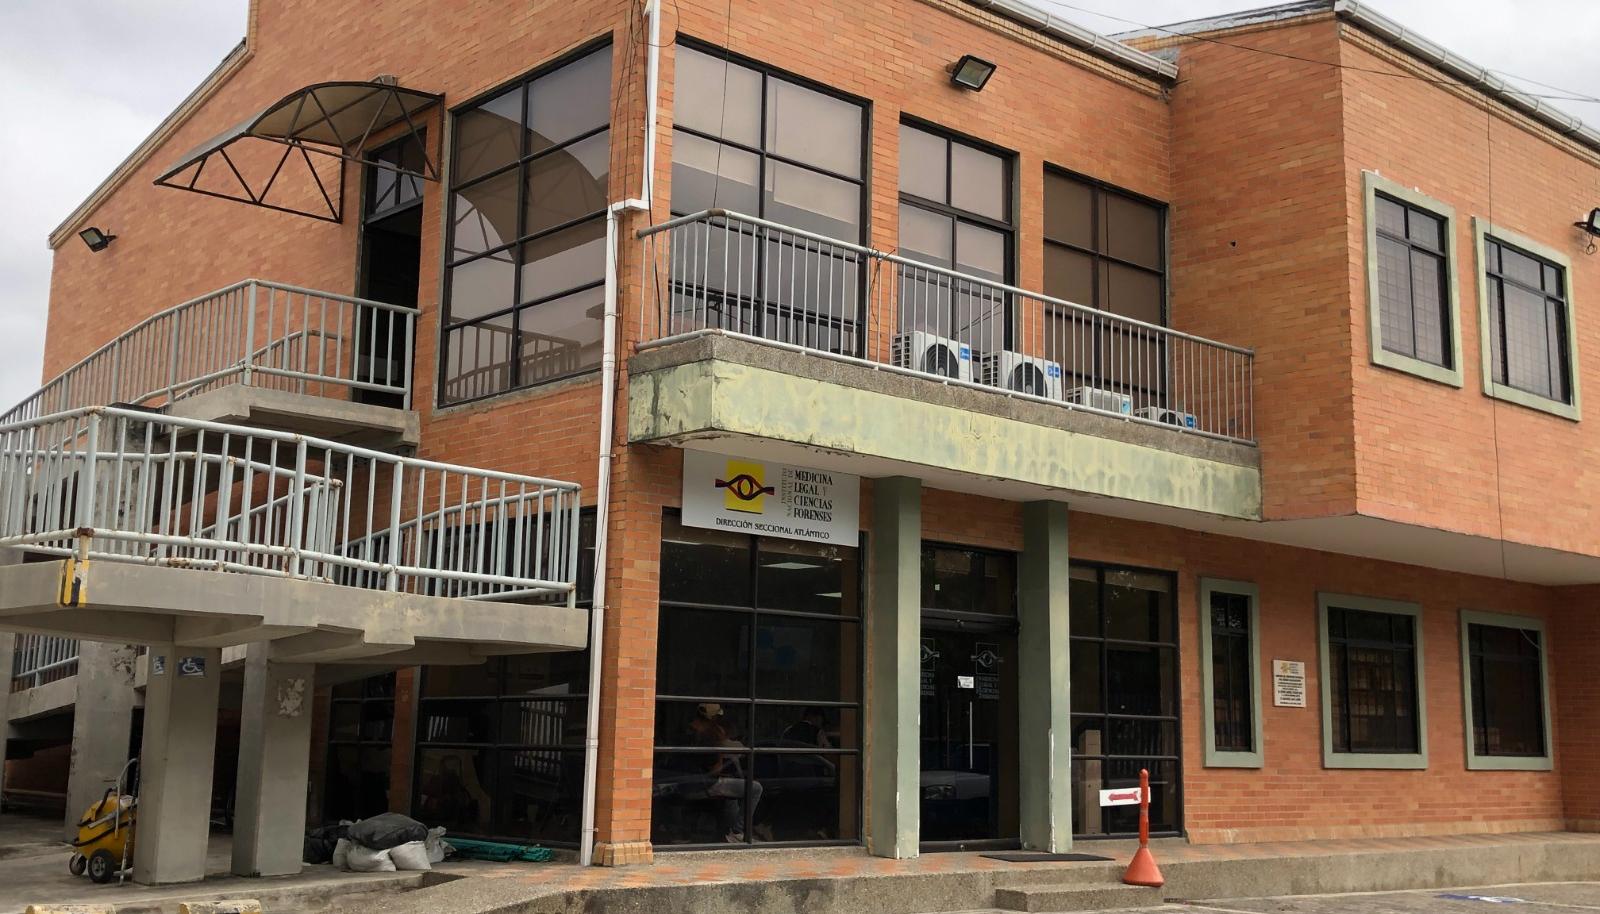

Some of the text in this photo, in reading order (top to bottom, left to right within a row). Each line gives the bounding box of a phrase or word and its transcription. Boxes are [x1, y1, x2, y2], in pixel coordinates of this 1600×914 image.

[794, 470, 833, 485] MEDICINA
[794, 482, 820, 496] LEGAL
[794, 495, 833, 510] CIENCIAS
[793, 507, 832, 522] FORENSES
[716, 517, 830, 540] DIRECCIÓN SECCIONAL ATLÁNTICO
